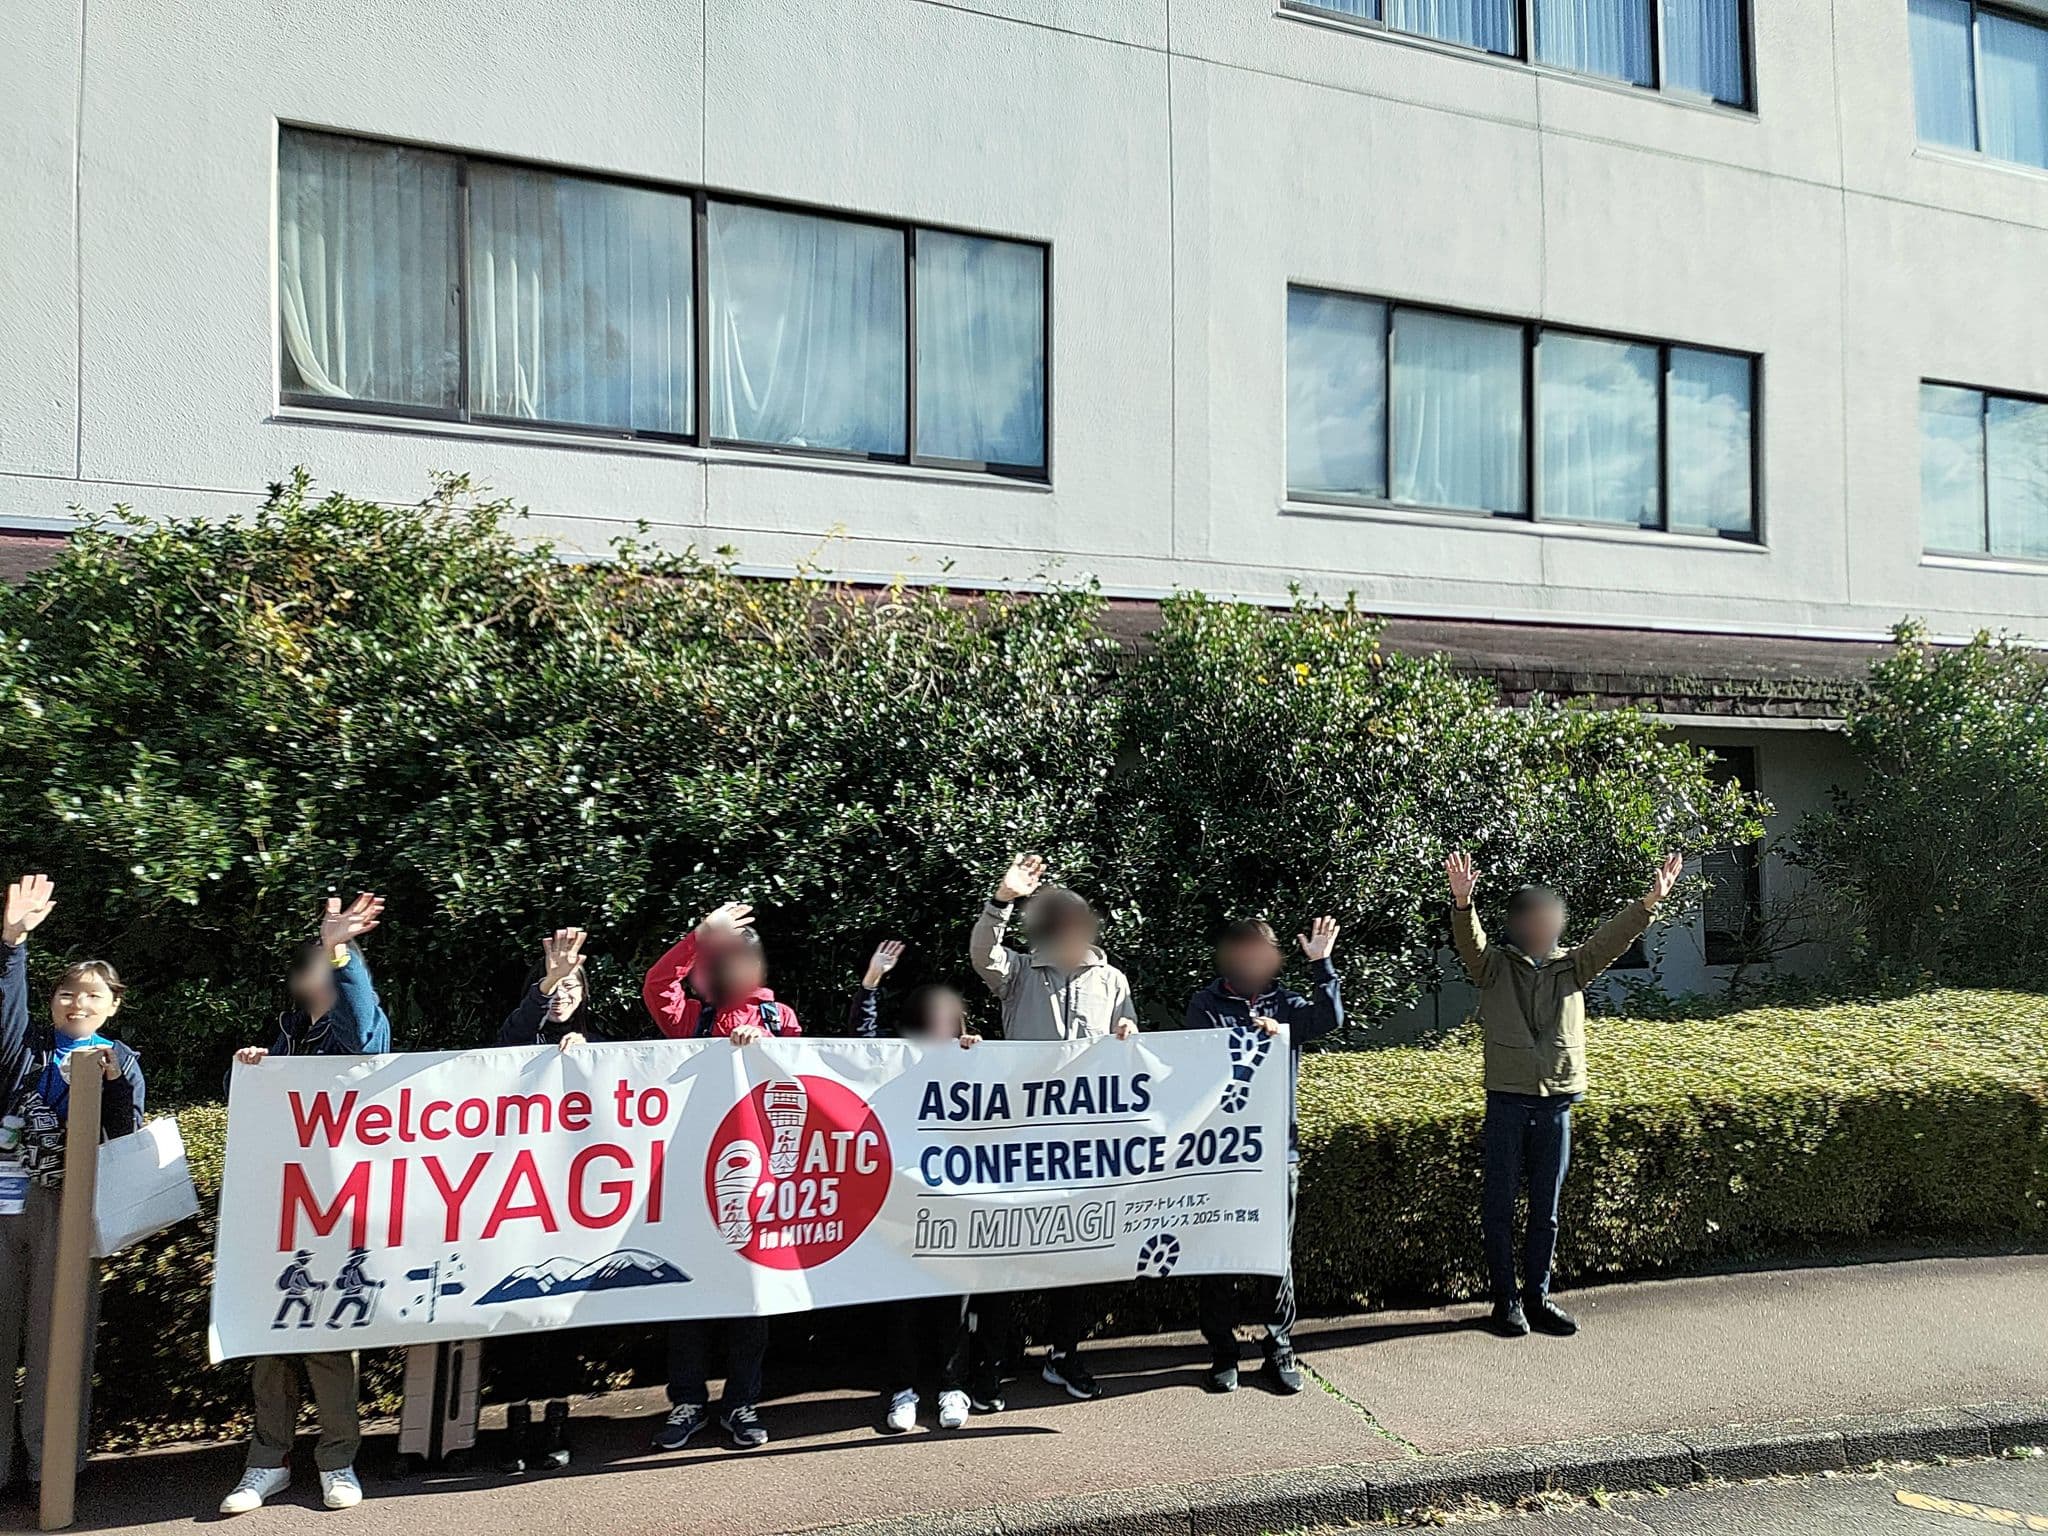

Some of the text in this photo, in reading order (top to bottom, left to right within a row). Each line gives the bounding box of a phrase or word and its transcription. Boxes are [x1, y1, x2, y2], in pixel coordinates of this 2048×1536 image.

[288, 1079, 668, 1148] Welcome to
[918, 1072, 1151, 1121] ASIA TRAILS
[803, 1130, 879, 1174] ATC
[920, 1125, 1263, 1187] CONFERENCE 2025
[278, 1140, 664, 1252] MIYAGI
[756, 1178, 839, 1222] 2025
[914, 1200, 1117, 1250] in MIYAGI
[1123, 1213, 1189, 1233] カンファレンス
[1193, 1210, 1220, 1225] 2025
